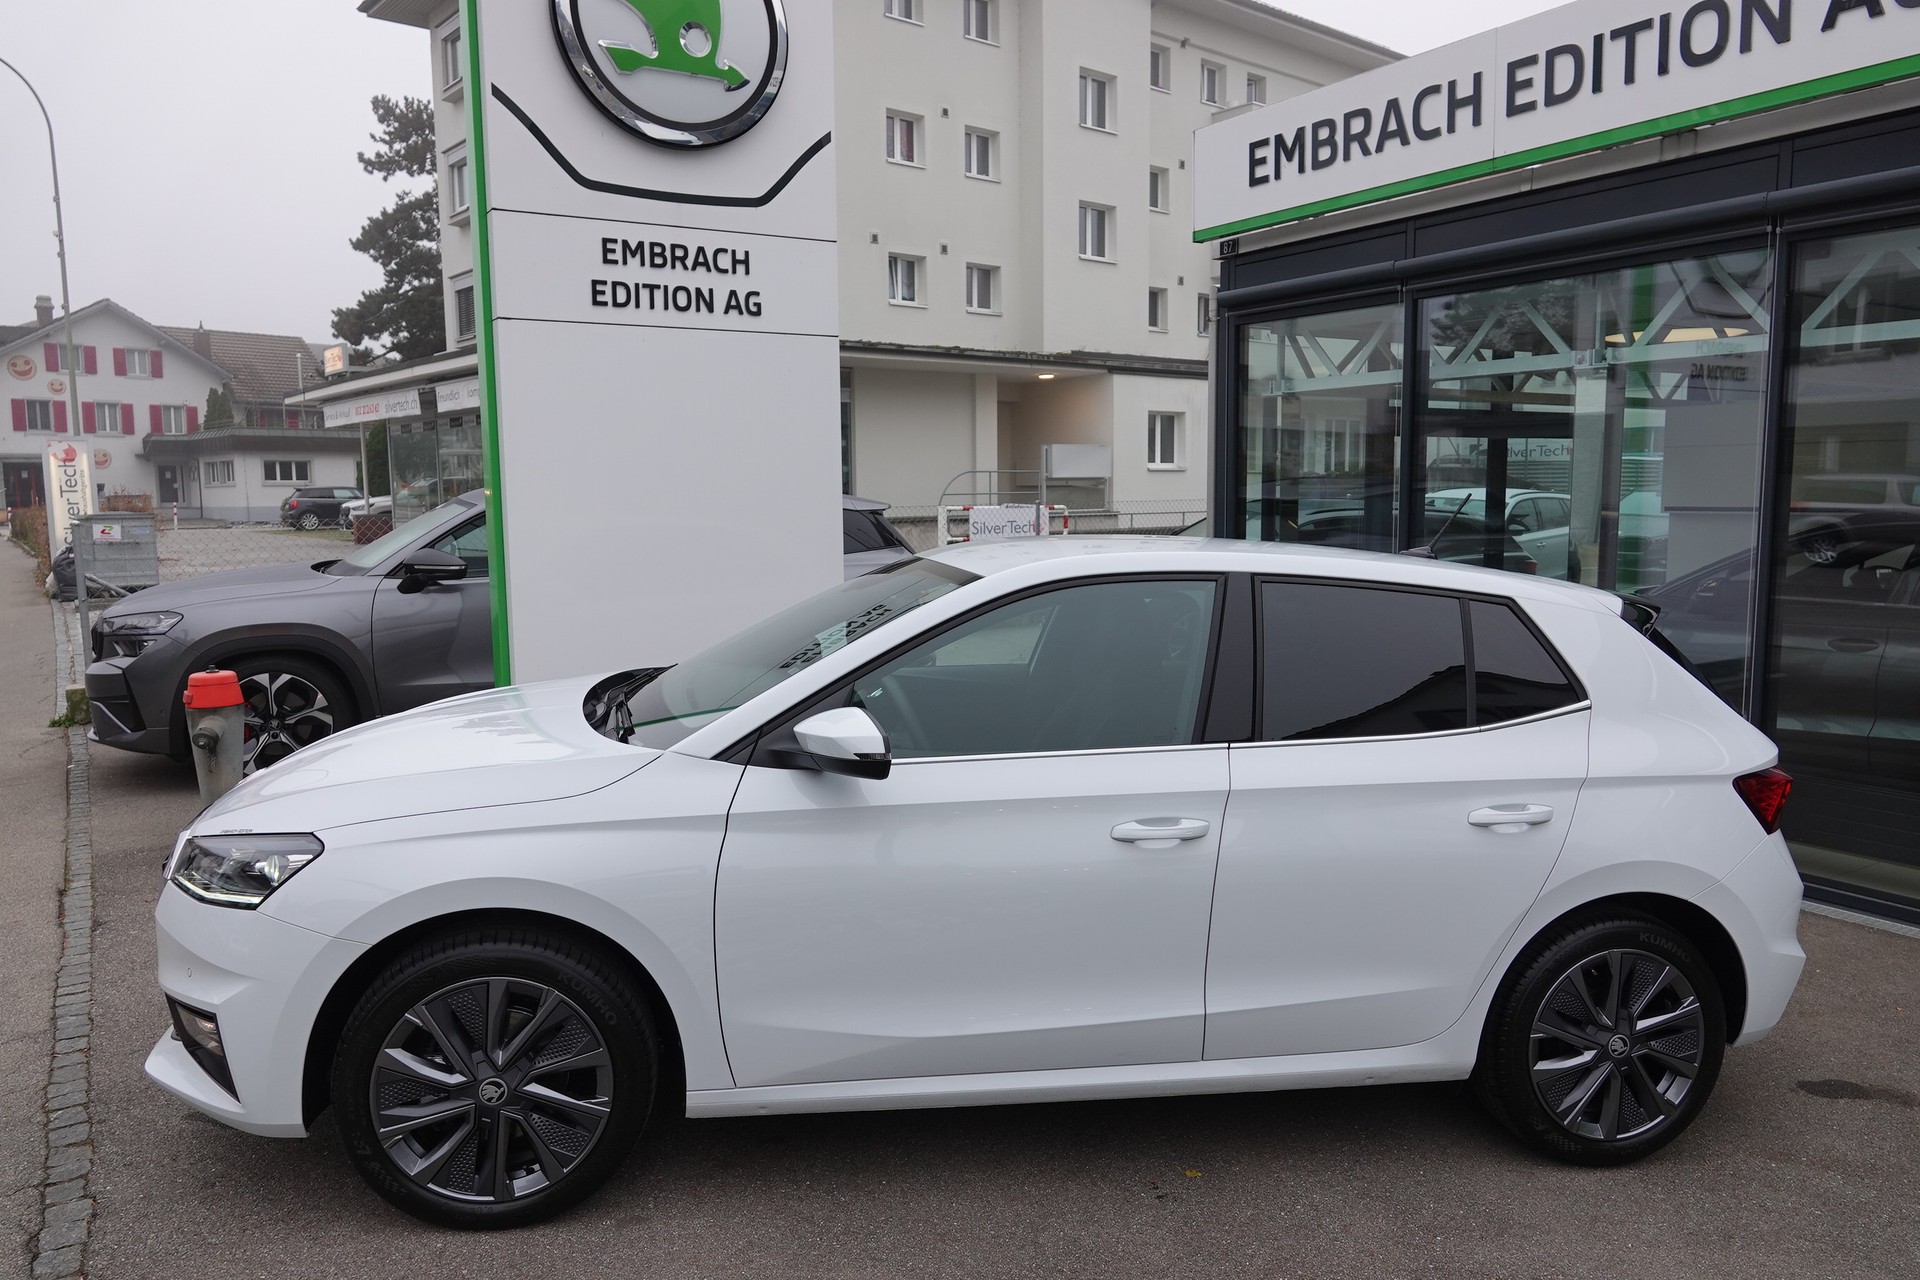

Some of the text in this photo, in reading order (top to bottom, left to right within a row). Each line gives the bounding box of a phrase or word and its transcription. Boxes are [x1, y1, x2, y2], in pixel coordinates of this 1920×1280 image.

[1248, 71, 1483, 188] EMBRACH
[1506, 0, 1792, 118] EDITION
[602, 237, 750, 276] EMBRACH
[1223, 241, 1233, 254] 87
[591, 279, 762, 317] EDITION AG
[1639, 931, 1692, 963] KUMHO
[559, 971, 618, 1026] KUMHO
